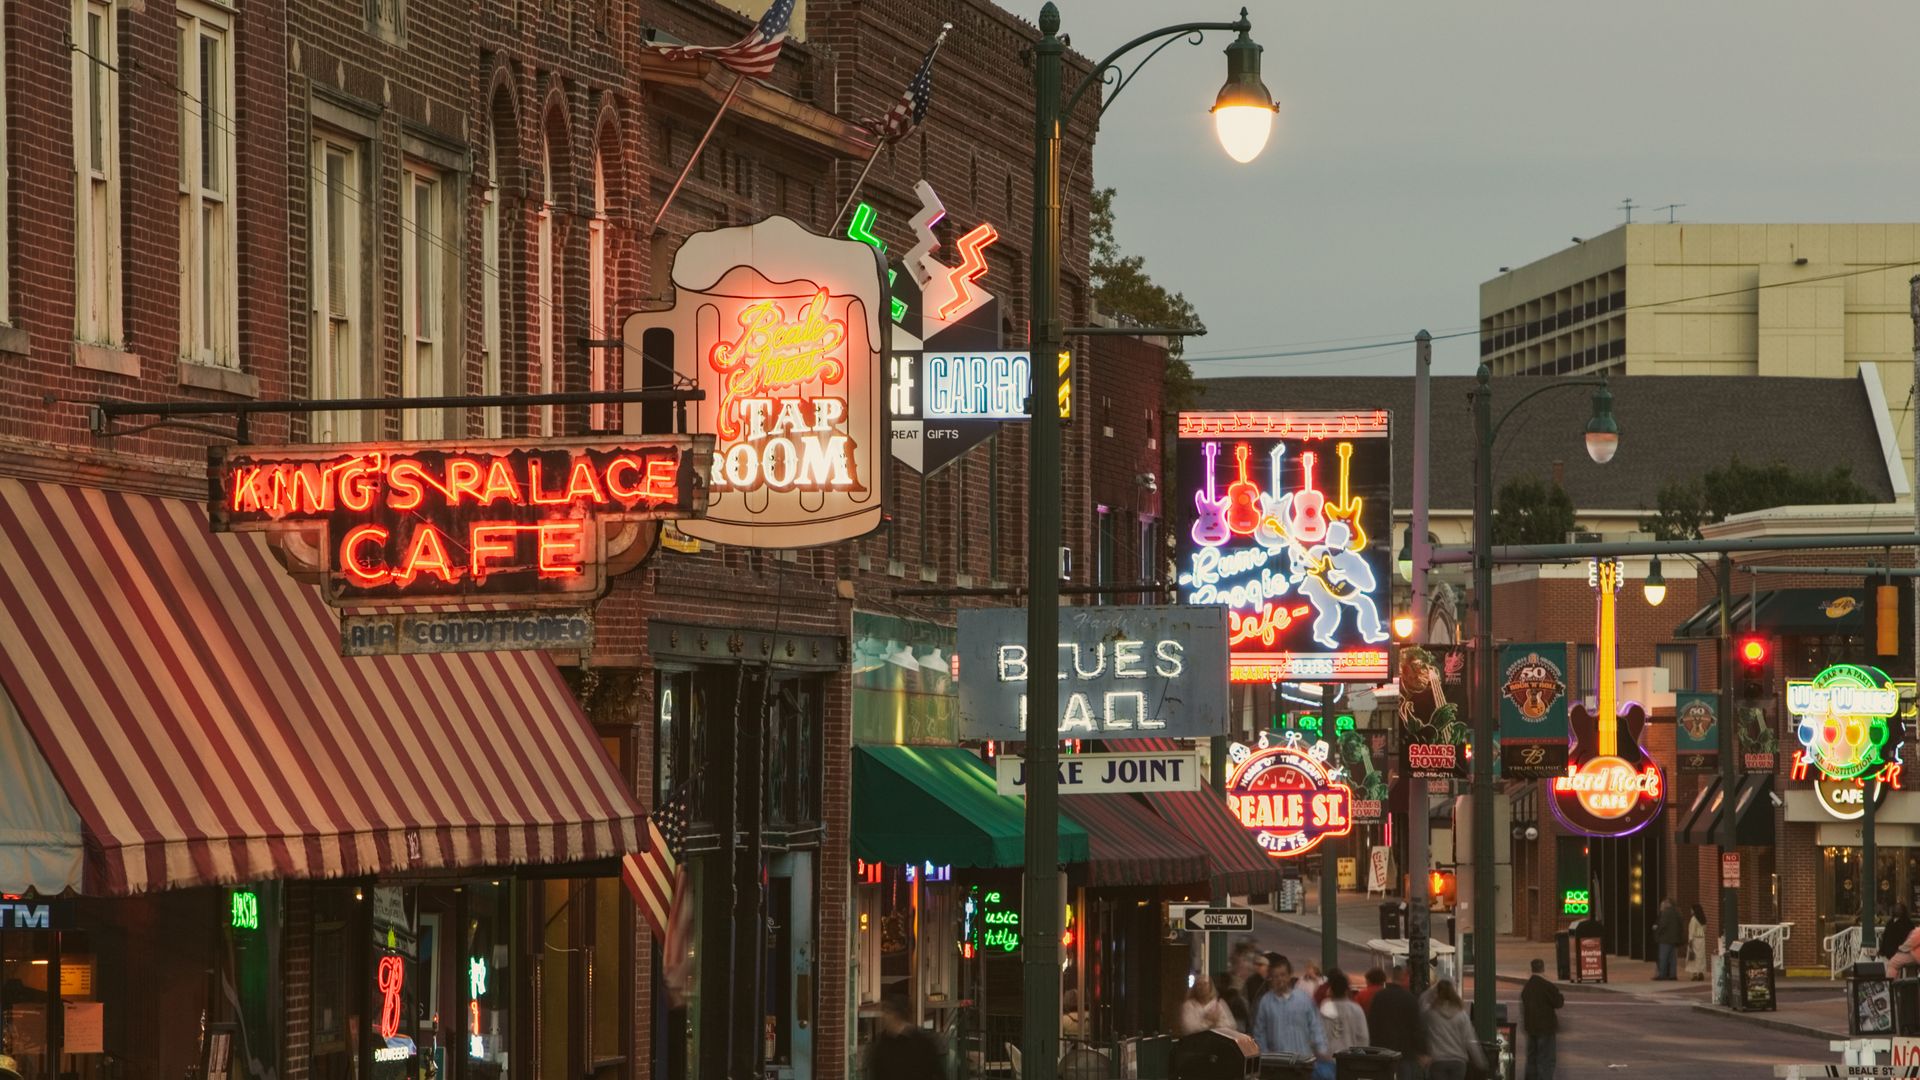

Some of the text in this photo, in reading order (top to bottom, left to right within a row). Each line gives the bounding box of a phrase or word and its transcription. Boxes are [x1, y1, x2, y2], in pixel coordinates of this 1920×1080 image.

[716, 290, 846, 367] Beale
[929, 356, 1032, 414] CARGO
[738, 397, 846, 441] TAP
[891, 429, 960, 440] REAT GIFTS
[233, 452, 679, 512] KING'S PALACE
[342, 521, 585, 586] CAFE
[1191, 546, 1269, 589] Rum
[411, 615, 588, 645] CONDITIONED
[998, 639, 1185, 682] BUES
[1520, 666, 1546, 679] 50
[1409, 743, 1456, 756] SAM'S
[1410, 757, 1456, 768] TOWN
[1012, 758, 1185, 786] JKE JOINT
[1826, 754, 1873, 775] INSTITUTION
[1556, 764, 1660, 797] Hard Rock
[1228, 793, 1347, 827] BEALE ST.
[1589, 794, 1629, 809] CAFE
[1257, 832, 1308, 851] GIFTS
[1372, 850, 1387, 889] SALE
[985, 910, 1019, 925] usic
[1204, 915, 1245, 924] ONE WAY
[1848, 1066, 1896, 1076] BEALE ST.
